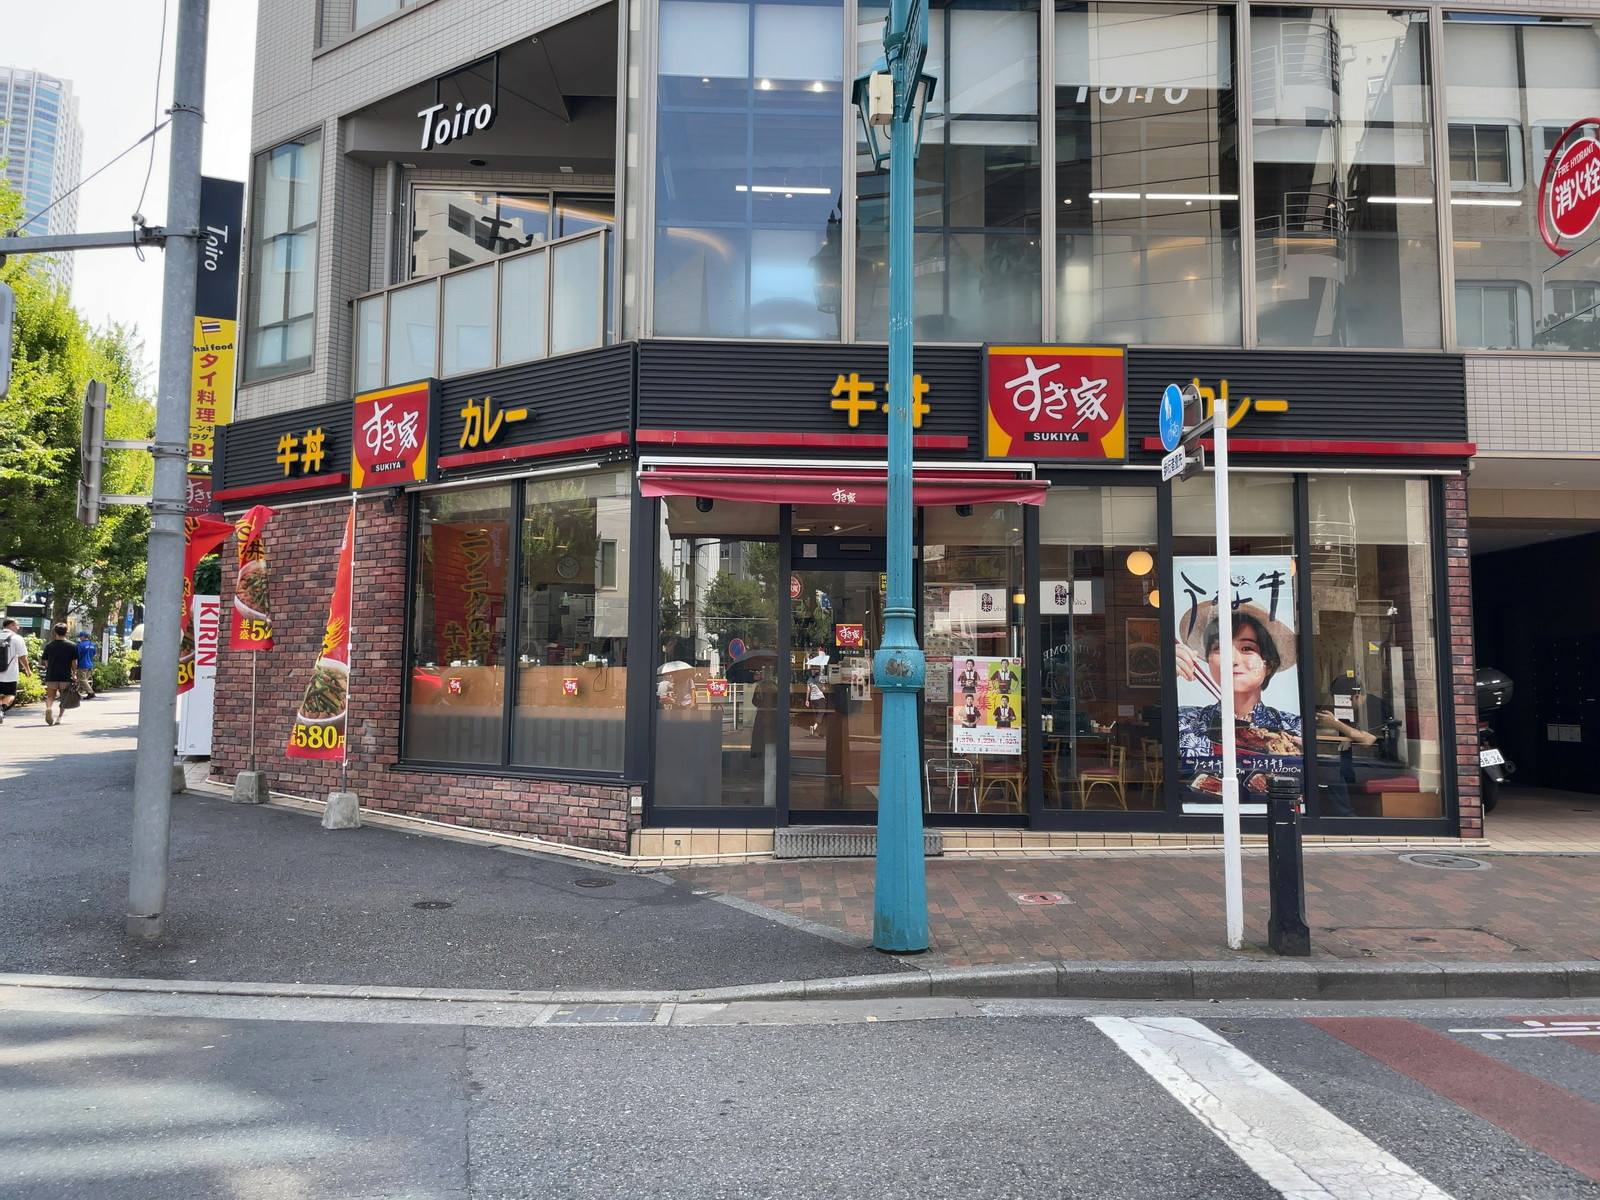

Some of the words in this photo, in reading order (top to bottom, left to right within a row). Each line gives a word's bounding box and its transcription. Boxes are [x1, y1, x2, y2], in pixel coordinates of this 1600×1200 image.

[417, 102, 492, 150] Toiro
[1558, 161, 1570, 178] FIRE
[1570, 142, 1595, 168] HYDRANT
[1555, 157, 1600, 219] 消火栓
[204, 225, 228, 271] Toiro
[210, 342, 234, 351] food
[196, 353, 219, 423] タイ料理
[1004, 357, 1109, 429] すき家
[362, 401, 419, 459] すき家
[459, 396, 528, 449] カレー
[1033, 431, 1080, 442] SUKIYA
[276, 427, 325, 476] 牛丼
[375, 461, 401, 472] SUKIYA
[832, 488, 856, 504] すき家
[197, 602, 220, 666] KIRIN
